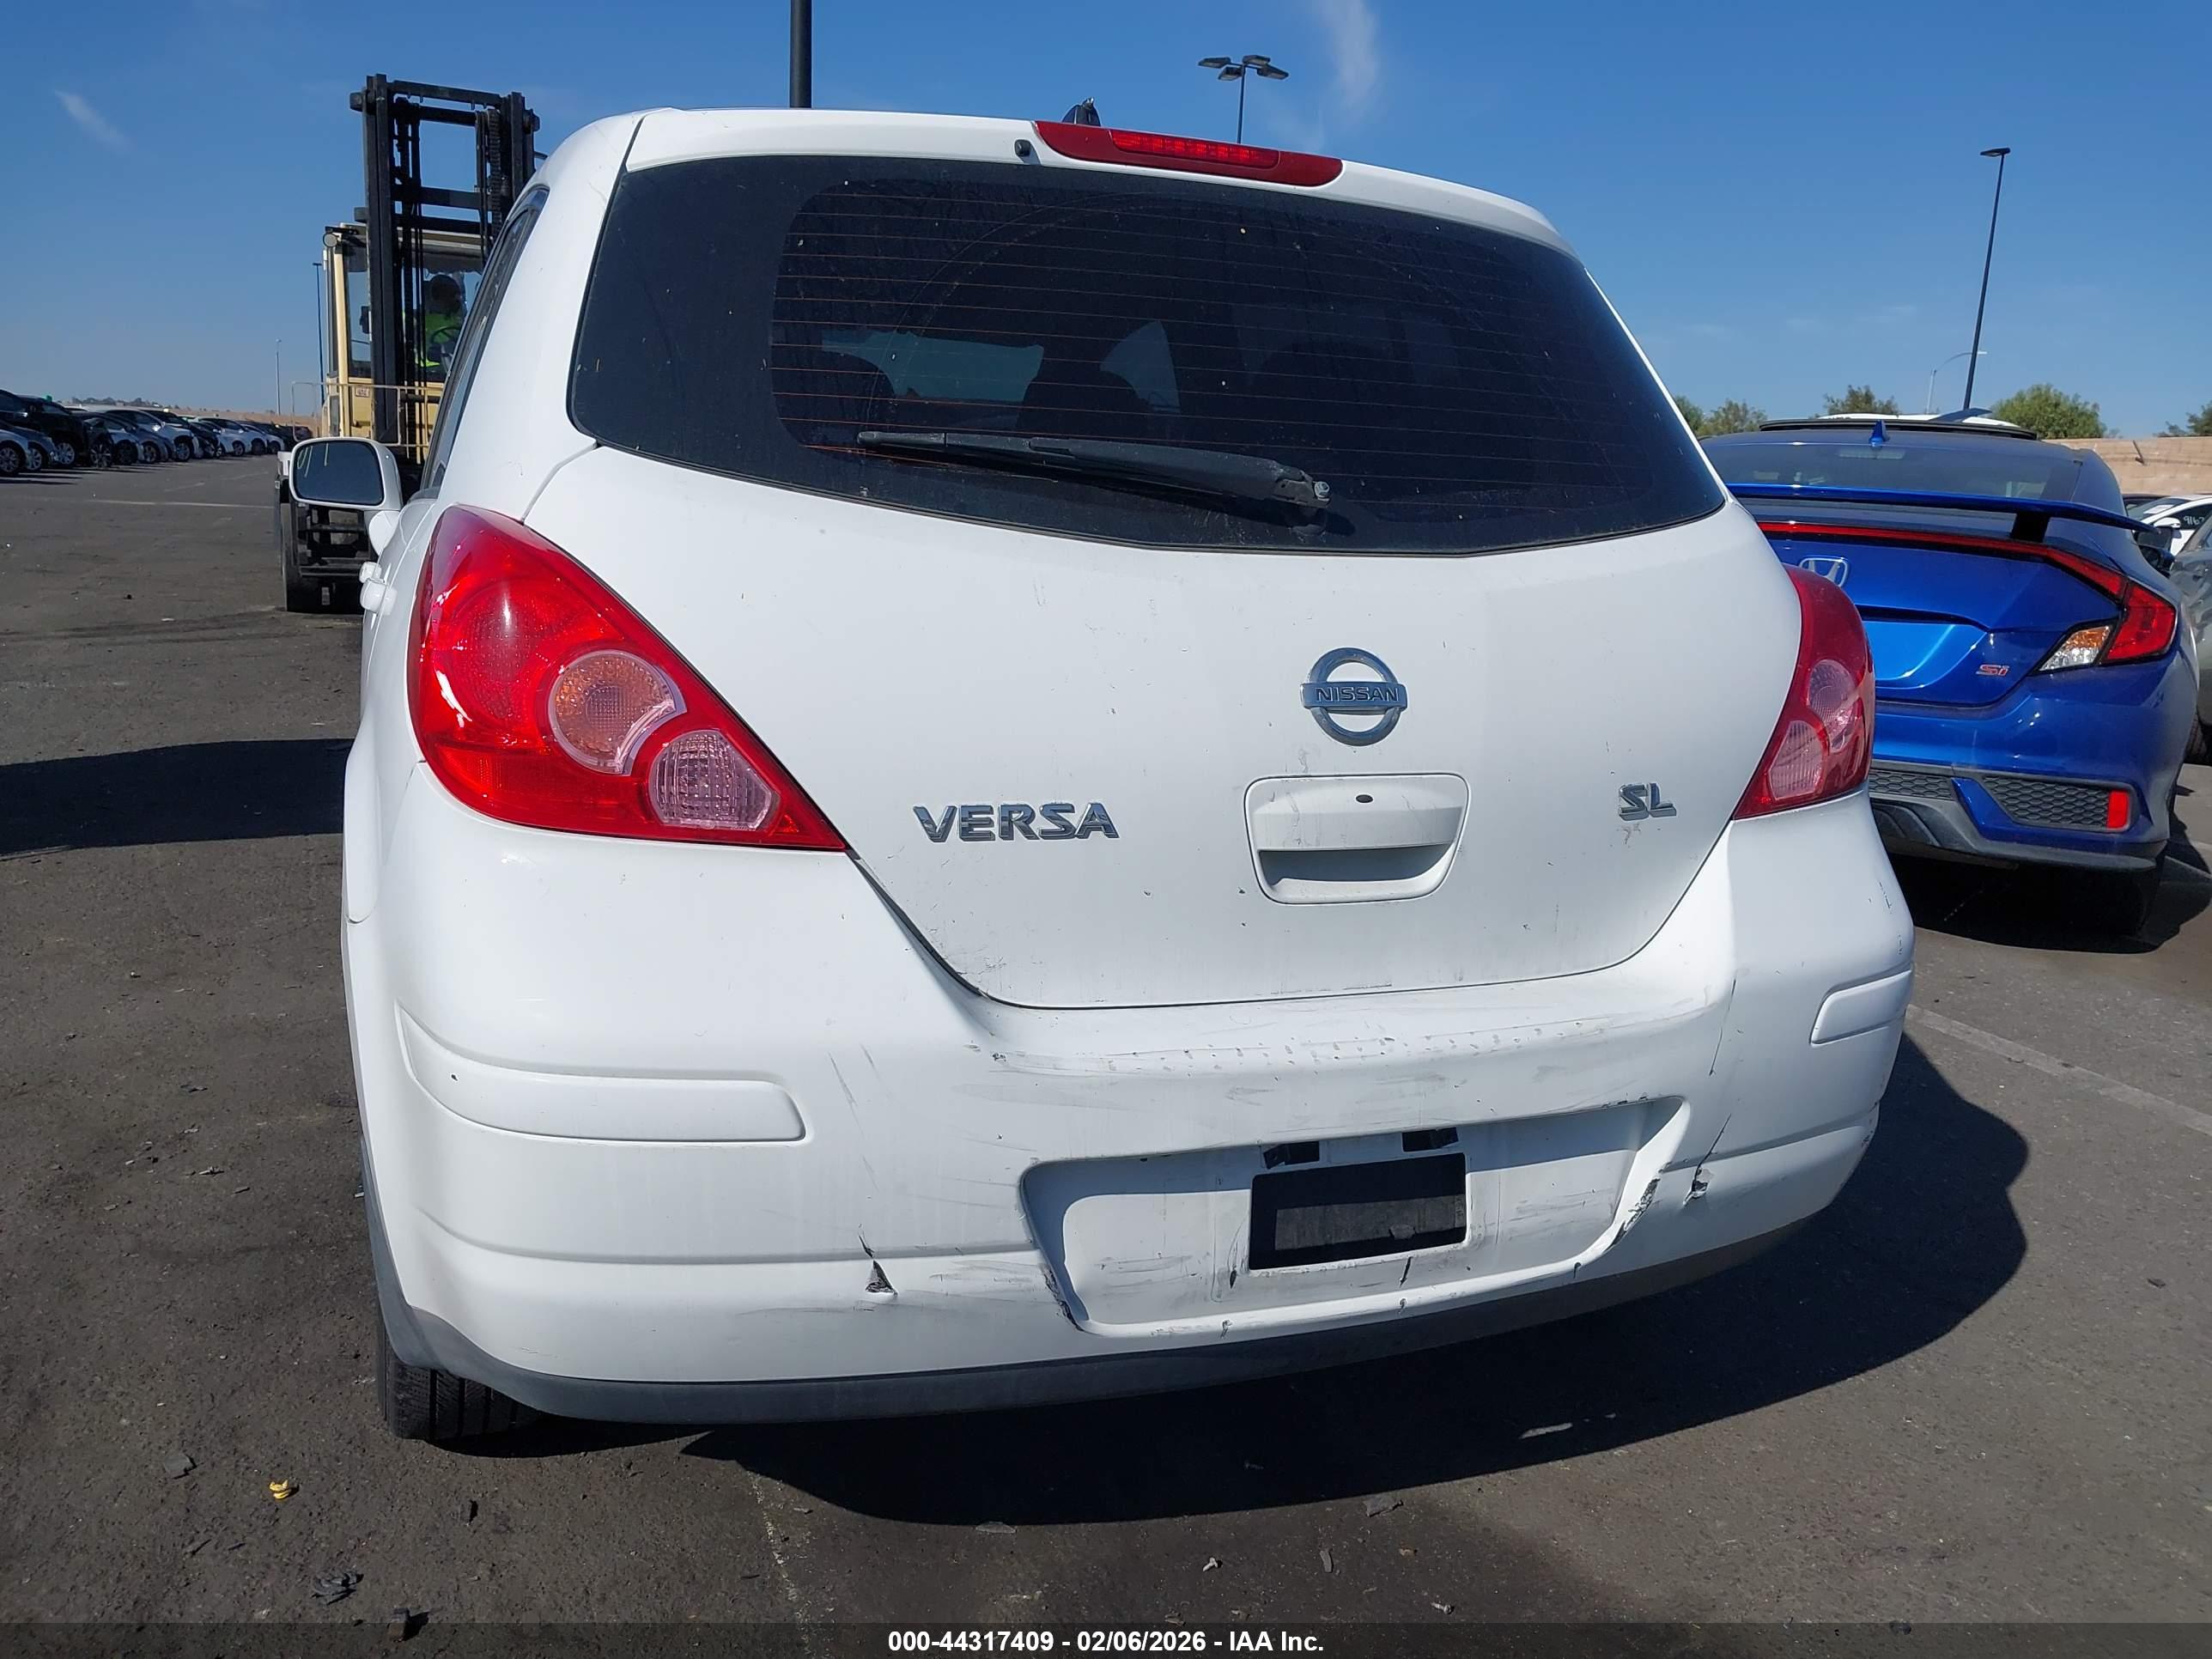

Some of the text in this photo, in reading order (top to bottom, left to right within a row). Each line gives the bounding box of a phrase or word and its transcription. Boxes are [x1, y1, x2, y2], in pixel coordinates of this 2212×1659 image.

[1976, 664, 2009, 677] Si
[1316, 686, 1399, 702] NISSAN
[1619, 782, 1677, 822] SL
[913, 802, 1120, 842] VERSA
